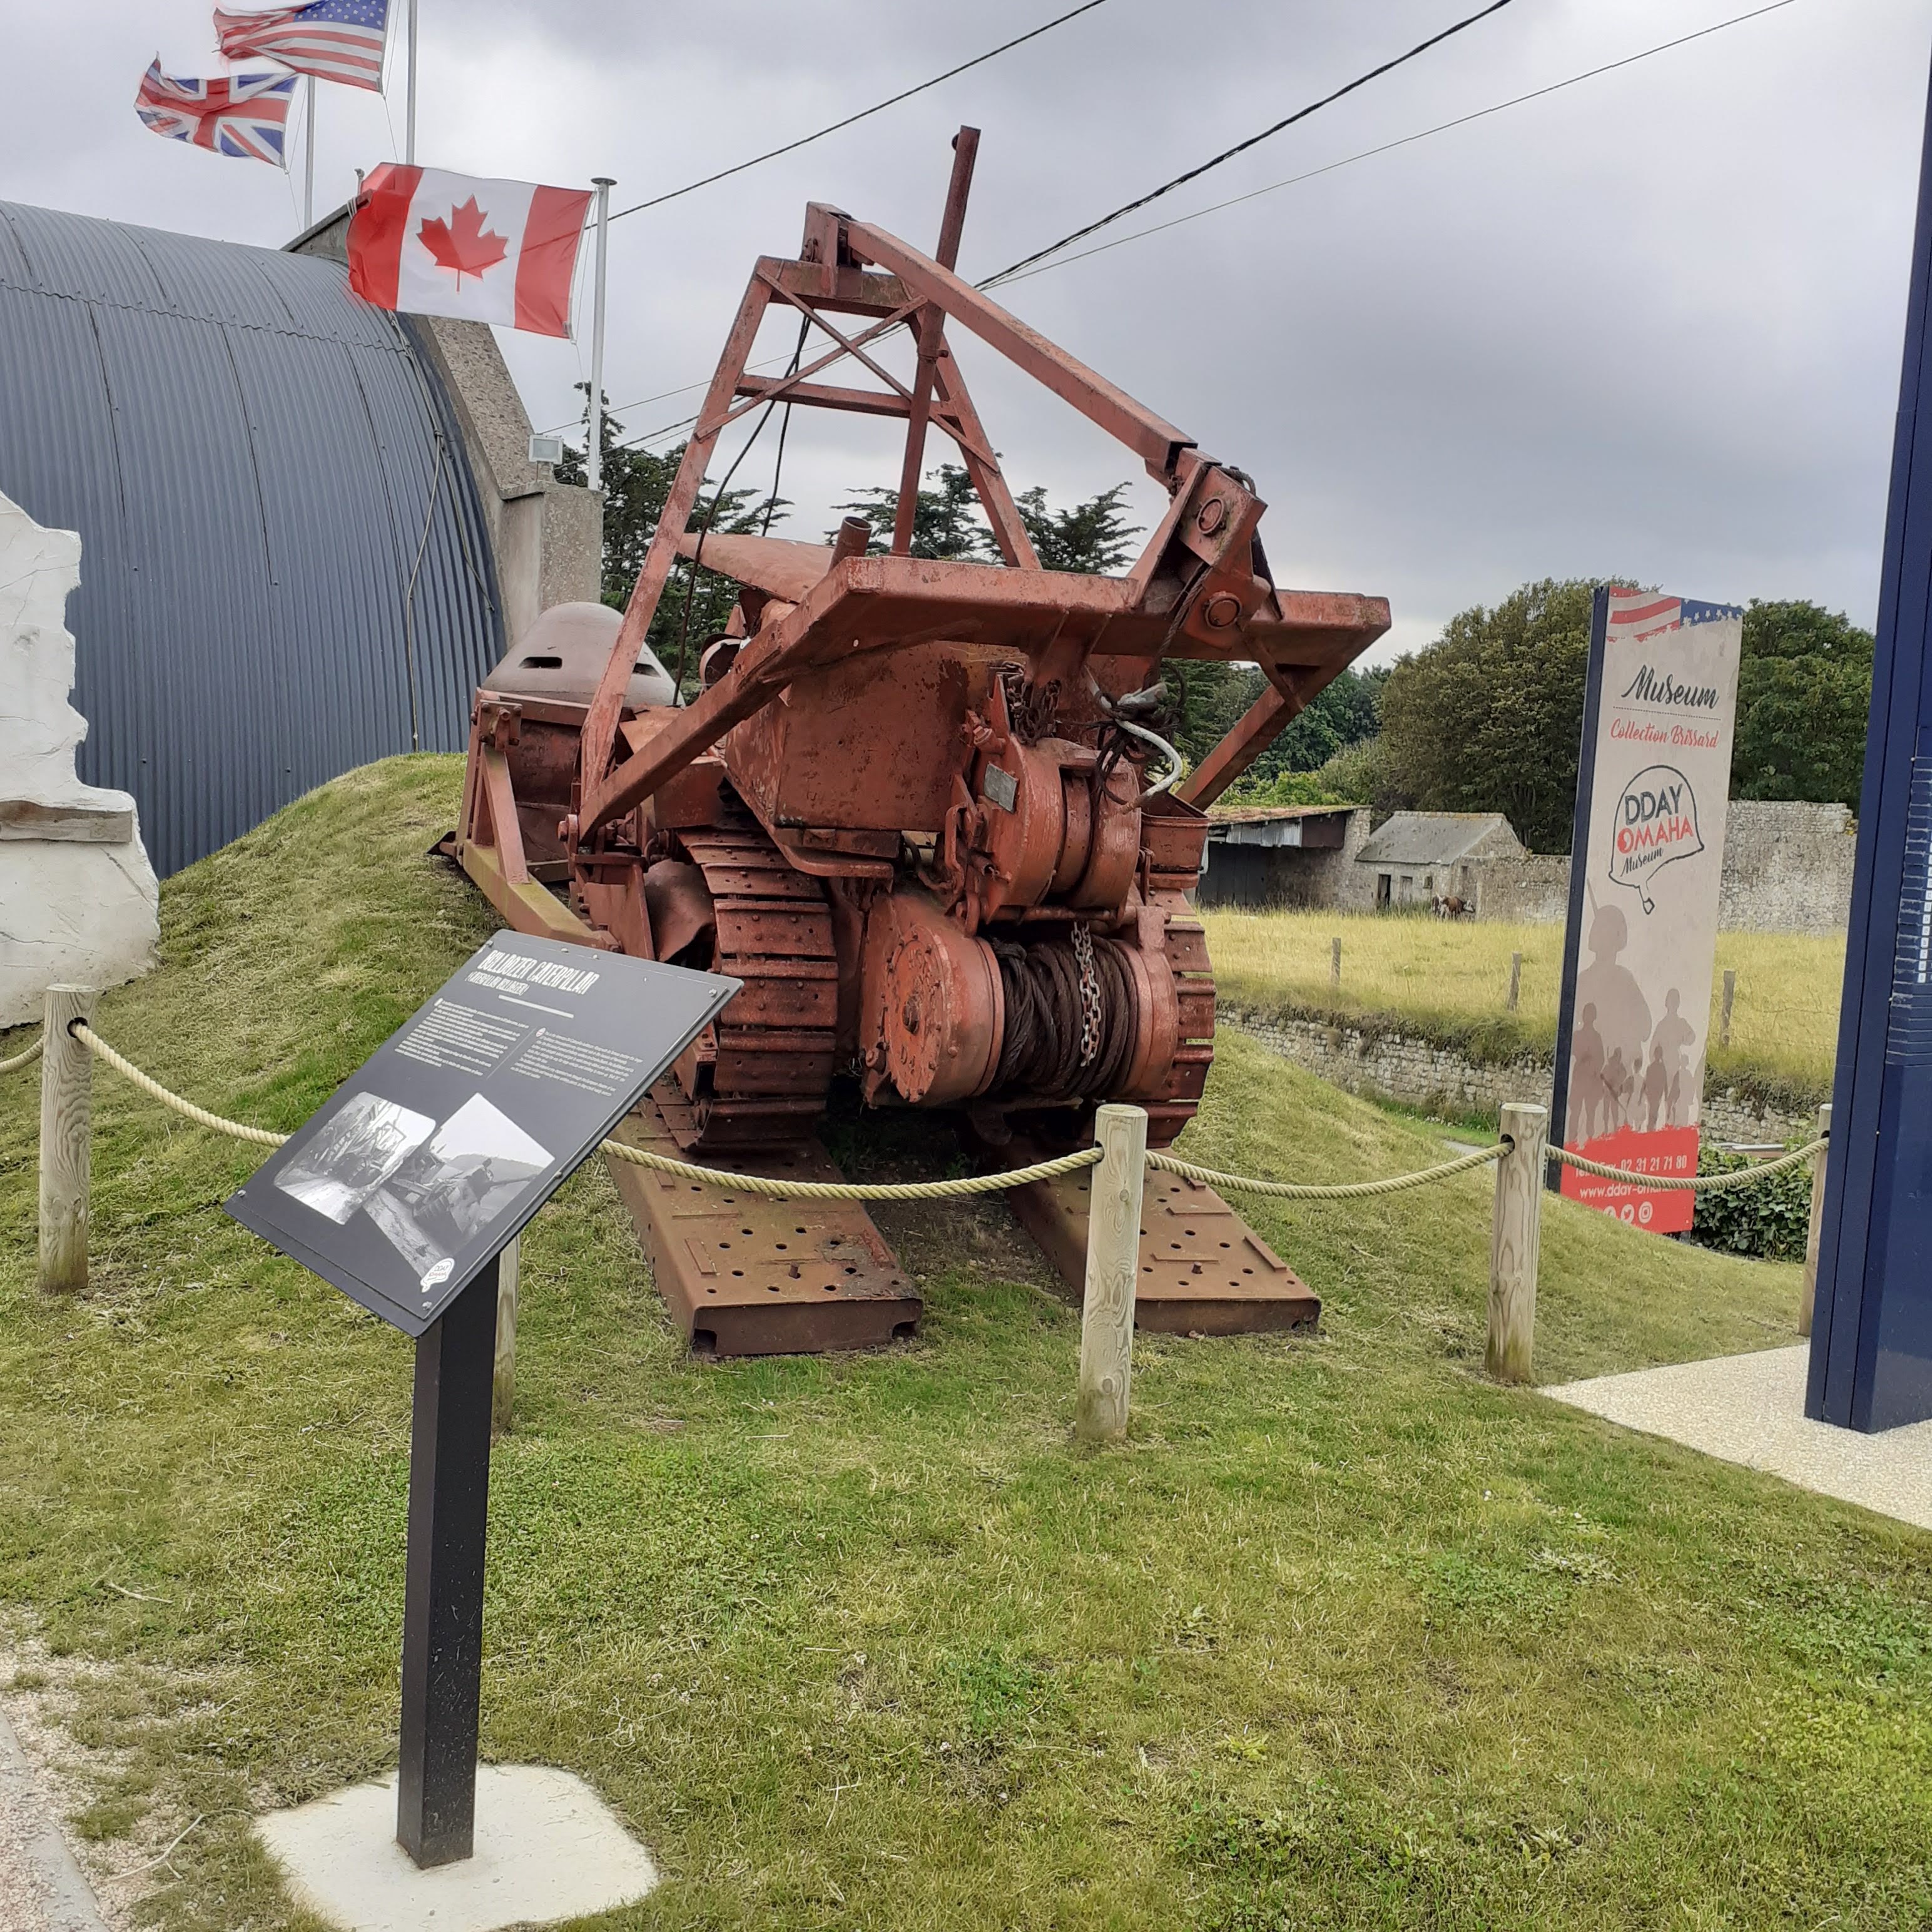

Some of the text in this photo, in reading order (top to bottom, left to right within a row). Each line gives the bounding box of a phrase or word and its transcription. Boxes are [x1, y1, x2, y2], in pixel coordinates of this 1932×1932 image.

[1621, 664, 1720, 709] Museum
[1610, 718, 1719, 748] Collection Brissard
[1625, 783, 1683, 826] DDAY
[1617, 815, 1694, 853] OMAHA
[1620, 847, 1664, 877] Museum
[477, 950, 600, 995] BULLDOZER CATERPILLAR
[1620, 1159, 1632, 1172] 02
[1636, 1157, 1647, 1172] 31
[1650, 1156, 1660, 1172] 21
[1664, 1156, 1673, 1171] 71
[1675, 1154, 1687, 1169] 80
